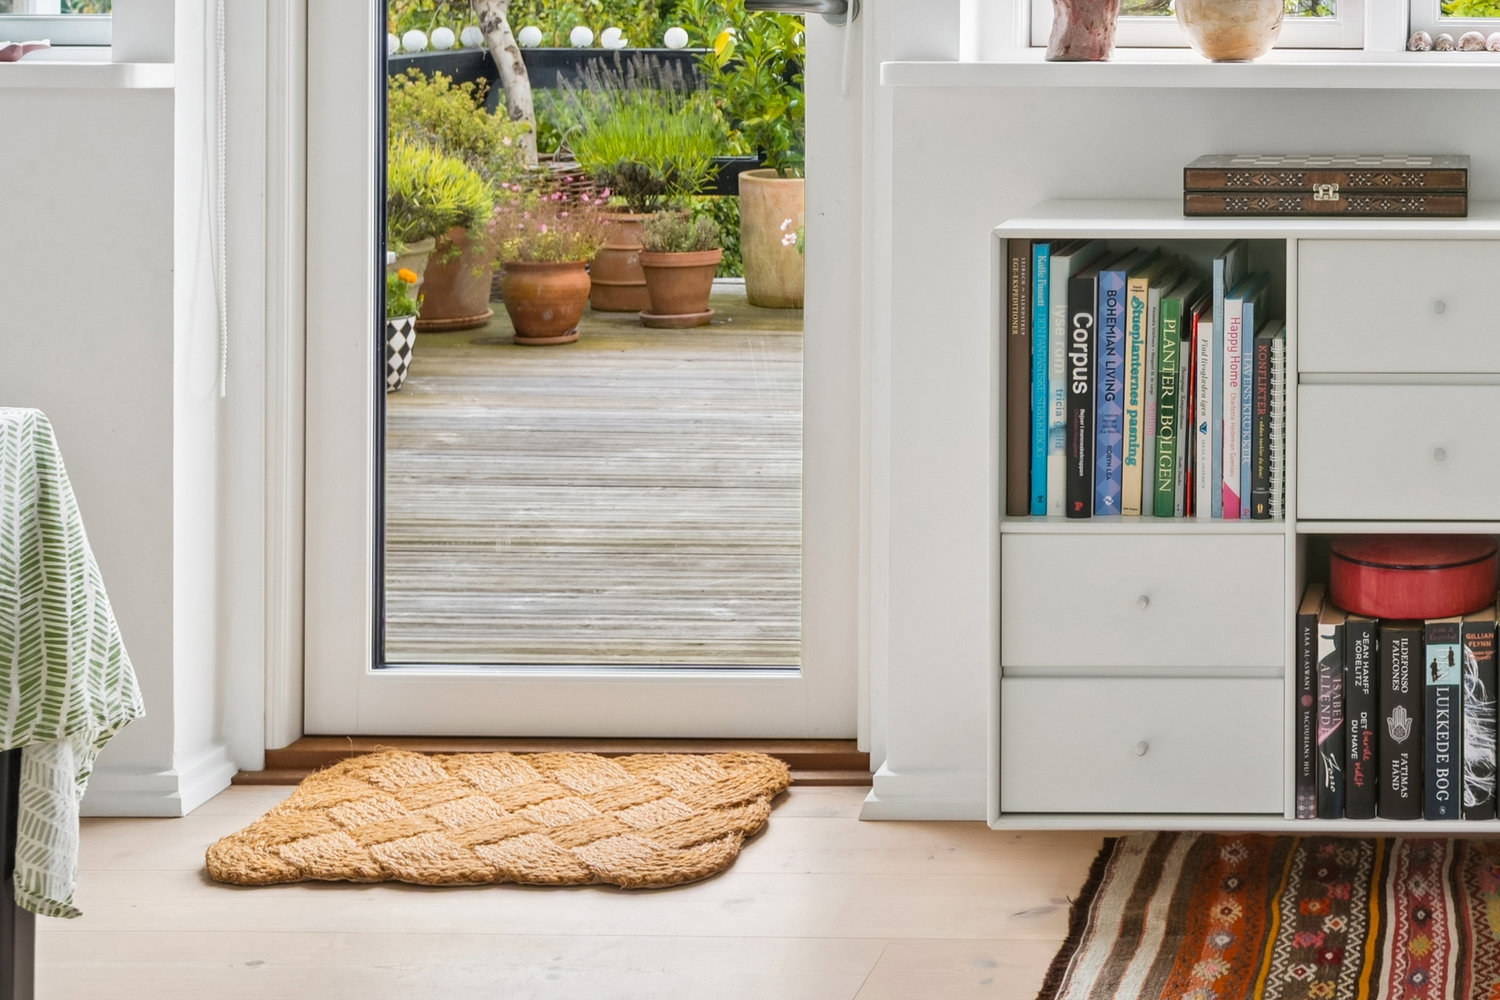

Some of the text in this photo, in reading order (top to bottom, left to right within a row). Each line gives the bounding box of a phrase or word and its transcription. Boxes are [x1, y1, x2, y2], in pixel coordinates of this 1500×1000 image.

[1037, 255, 1047, 307] Kaffe Fassett
[1052, 304, 1067, 374] lyse rom
[1105, 289, 1117, 356] BOHEMIAN
[1068, 312, 1094, 395] Corpus
[1199, 358, 1208, 398] livsglæden
[1227, 317, 1240, 388] Happy Home
[1055, 388, 1065, 416] tricia
[1104, 361, 1116, 402] LIVING
[1126, 296, 1145, 466] Stueplanternes pasning
[1158, 319, 1177, 492] PLANTER BOLIGEN
[1257, 345, 1267, 415] KONFLIKTER
[1199, 400, 1207, 416] igen
[1229, 392, 1237, 420] Charlotte
[1242, 352, 1252, 464] HAVENS KRUKKER
[1077, 408, 1086, 477] Rejser menneskekroppen
[1465, 632, 1494, 640] GILLIAN
[1468, 640, 1491, 648] FLYNN
[1354, 639, 1363, 687] KORELITZ
[1361, 631, 1370, 695] JEAN HANFF
[1391, 639, 1400, 691] FALCONES
[1400, 637, 1409, 693] ILDEFONSO
[1320, 663, 1331, 737] ALLENDE
[1332, 678, 1342, 725] ISABEL
[1351, 720, 1359, 733] DU
[1360, 711, 1373, 761] DET burde
[1435, 686, 1450, 801] LUKKEDE BOG
[1319, 751, 1342, 793] Zorro
[1353, 762, 1364, 787] vidst
[1391, 759, 1402, 790] HÅND
[1400, 752, 1408, 798] FATIMAS
